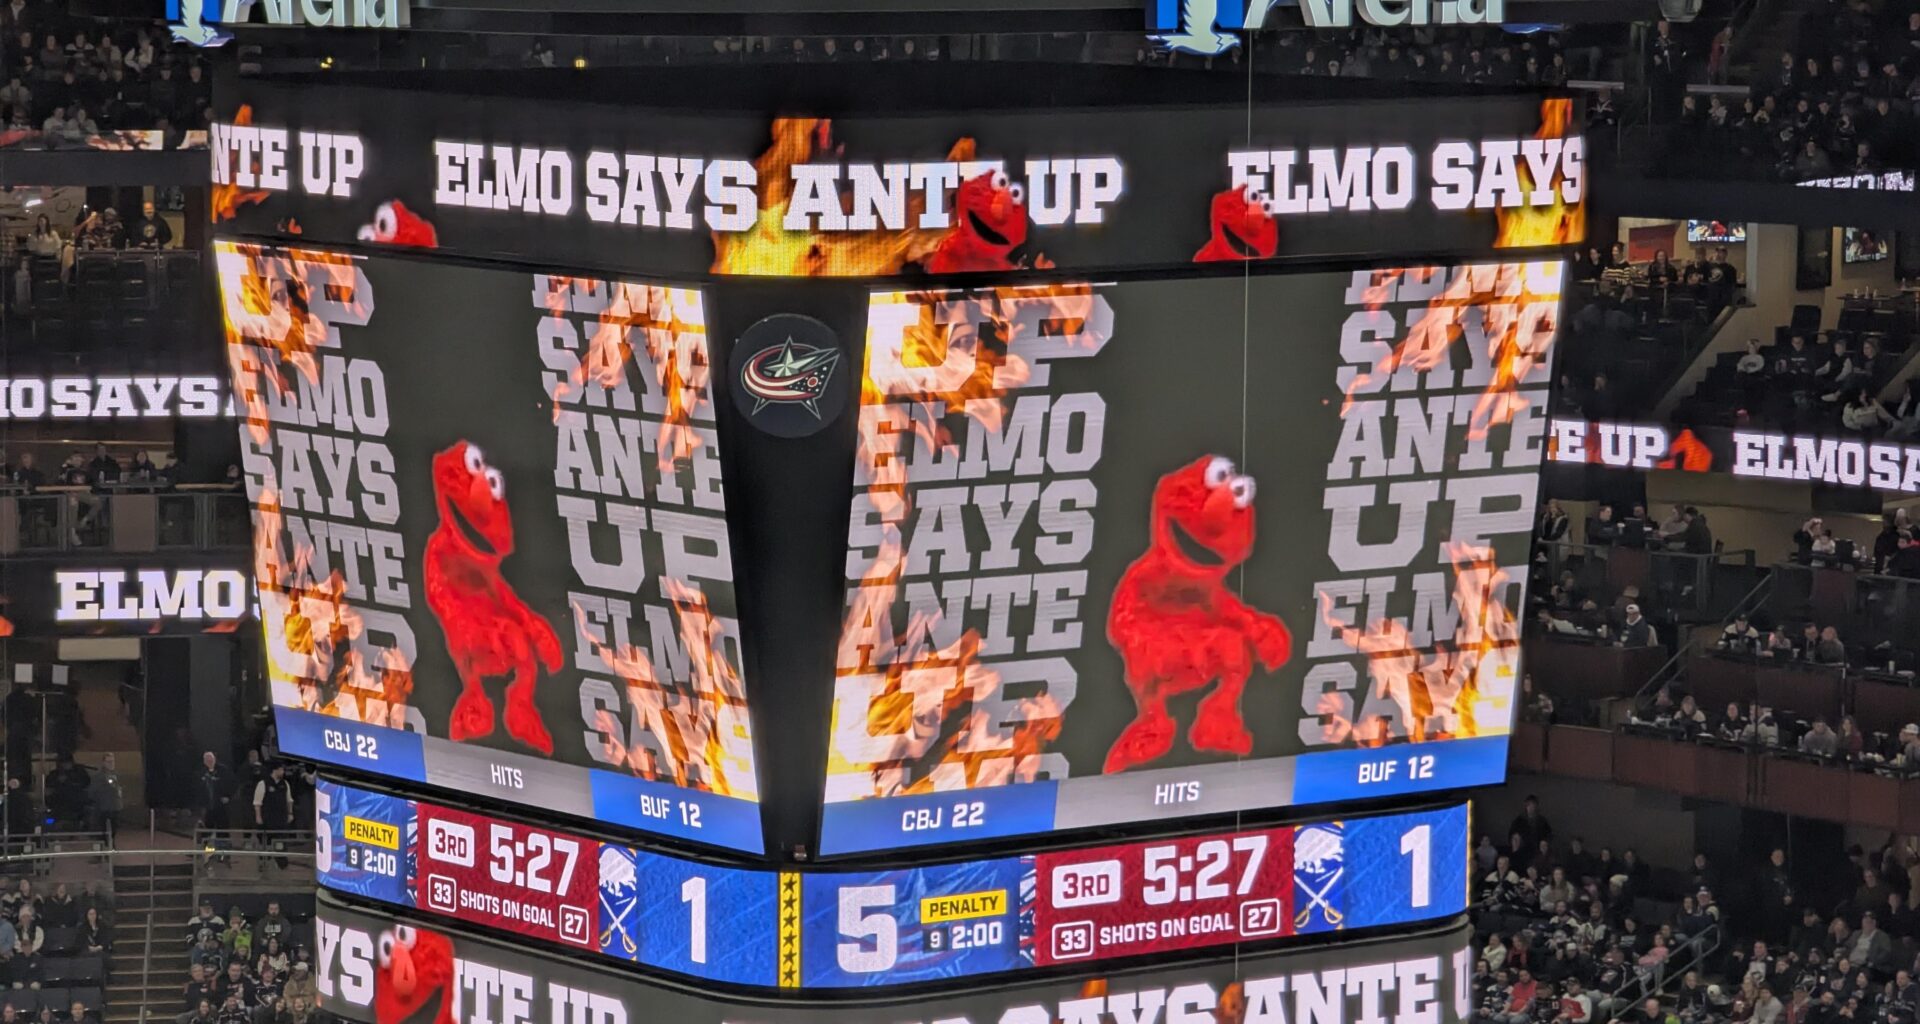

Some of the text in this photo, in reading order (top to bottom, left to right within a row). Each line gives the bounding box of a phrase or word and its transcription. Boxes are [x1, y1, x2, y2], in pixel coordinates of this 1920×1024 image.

[298, 131, 364, 197] UP
[434, 141, 1123, 232] ELMO SAYS ANT UP
[1228, 136, 1583, 214] ELMO SAYS
[215, 252, 375, 348] UP
[536, 316, 716, 422] SAYS
[867, 294, 1115, 395] UP
[1336, 301, 1559, 395] SAYS
[228, 343, 390, 437] ELMO
[239, 423, 401, 524] SAYS
[553, 409, 727, 512] ANTE
[853, 392, 1107, 486] ELMO
[1326, 389, 1549, 480] ANTE
[1598, 424, 1669, 468] UP
[250, 509, 411, 609] ANTE
[556, 495, 734, 600] UP
[845, 478, 1098, 580] SAYS
[1323, 473, 1539, 572] UP
[56, 570, 246, 620] ELMO
[836, 570, 1088, 670] ANTE
[1306, 565, 1529, 658] ELMO
[567, 591, 747, 702] ELMO
[324, 729, 379, 760] CBJ 22
[490, 764, 524, 789] HITS
[1358, 755, 1435, 784] BUF 12
[349, 821, 395, 844] PENALTY
[640, 794, 702, 828] BUF 12
[901, 801, 985, 832] CBJ 22
[1154, 781, 1200, 806] HITS
[350, 848, 397, 877] 9 2:00
[435, 827, 467, 858] 3RD
[490, 823, 579, 896] 5:27
[1143, 835, 1268, 905] 5:27
[1400, 824, 1430, 908] 1
[434, 882, 583, 935] 33 SHOTS ON GOAL 27
[681, 876, 706, 964] 1
[929, 896, 999, 917] PENALTY
[1062, 872, 1110, 899] 3RD
[837, 884, 898, 973] 5
[929, 921, 1003, 950] 9 2:00
[1060, 906, 1273, 951] 33 SHOTS ON GOAL 27
[1243, 956, 1441, 1024] ANTE
